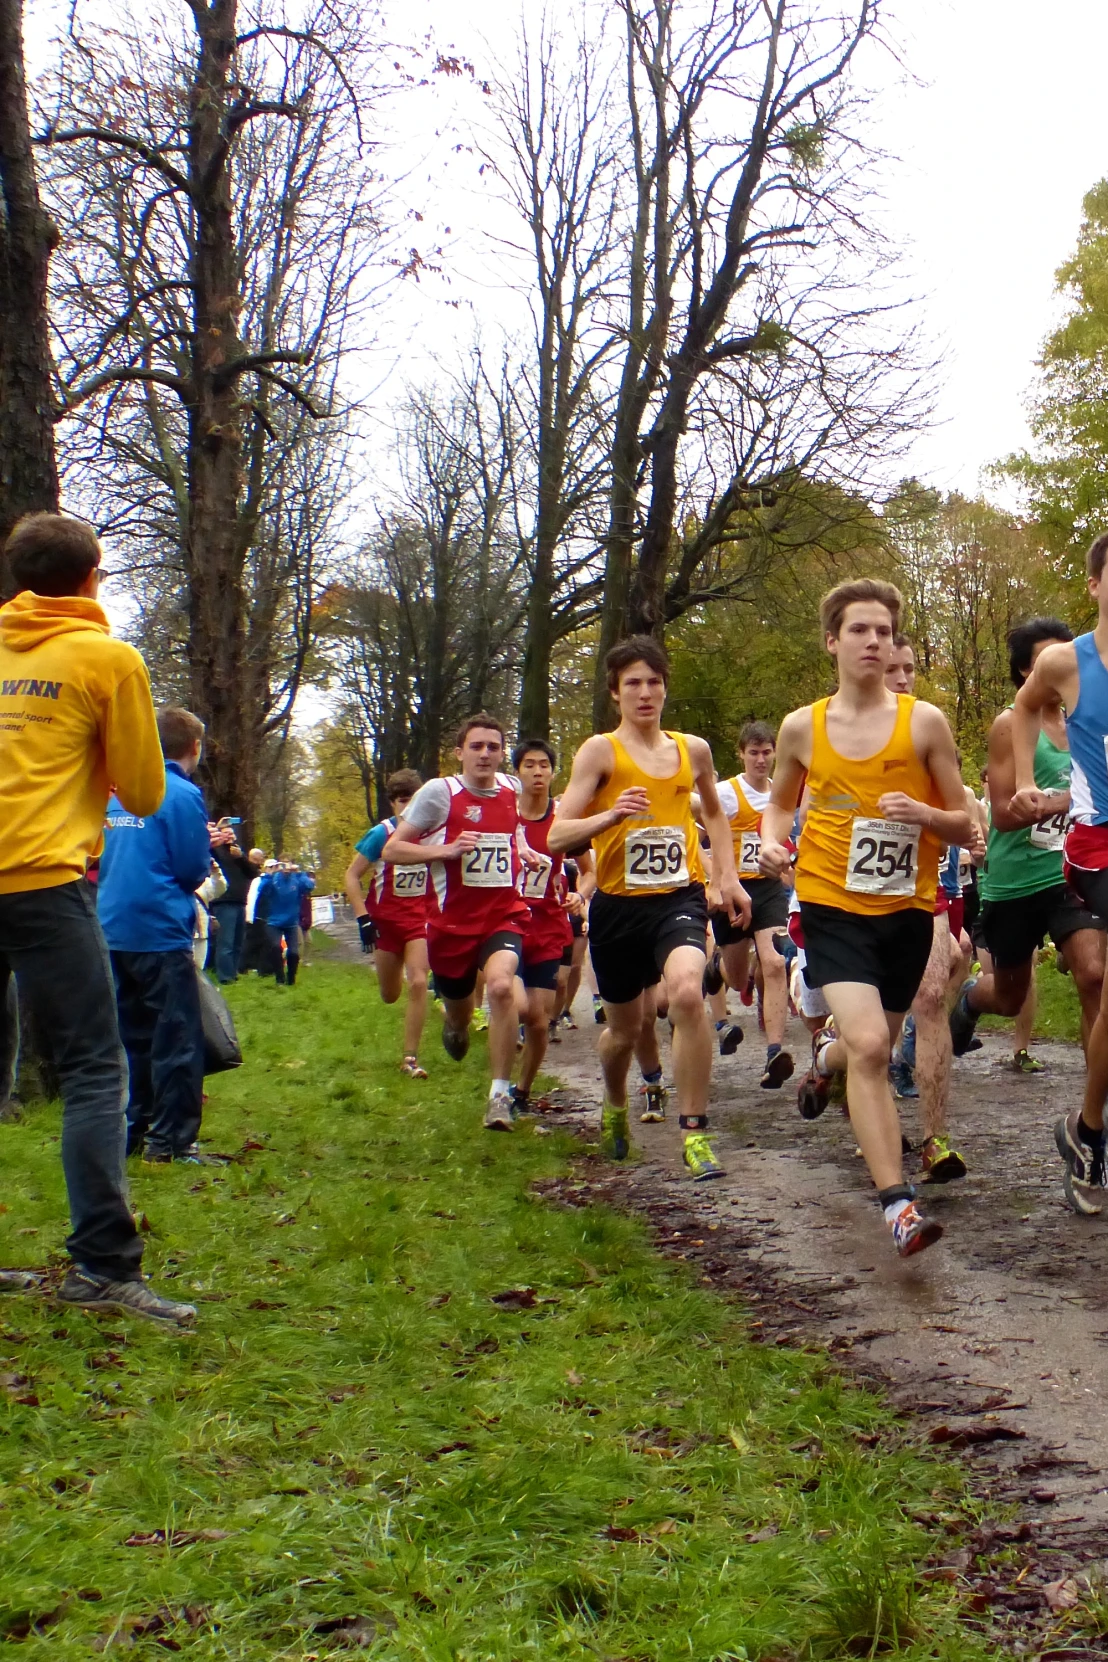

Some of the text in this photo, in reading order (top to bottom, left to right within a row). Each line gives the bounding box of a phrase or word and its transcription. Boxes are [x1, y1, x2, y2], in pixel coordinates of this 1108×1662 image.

[1, 679, 63, 700] WINN
[25, 713, 52, 724] sport
[466, 847, 508, 873] 275
[630, 842, 682, 875] 259
[743, 843, 761, 863] 25
[853, 837, 914, 878] 254
[396, 871, 426, 888] 279
